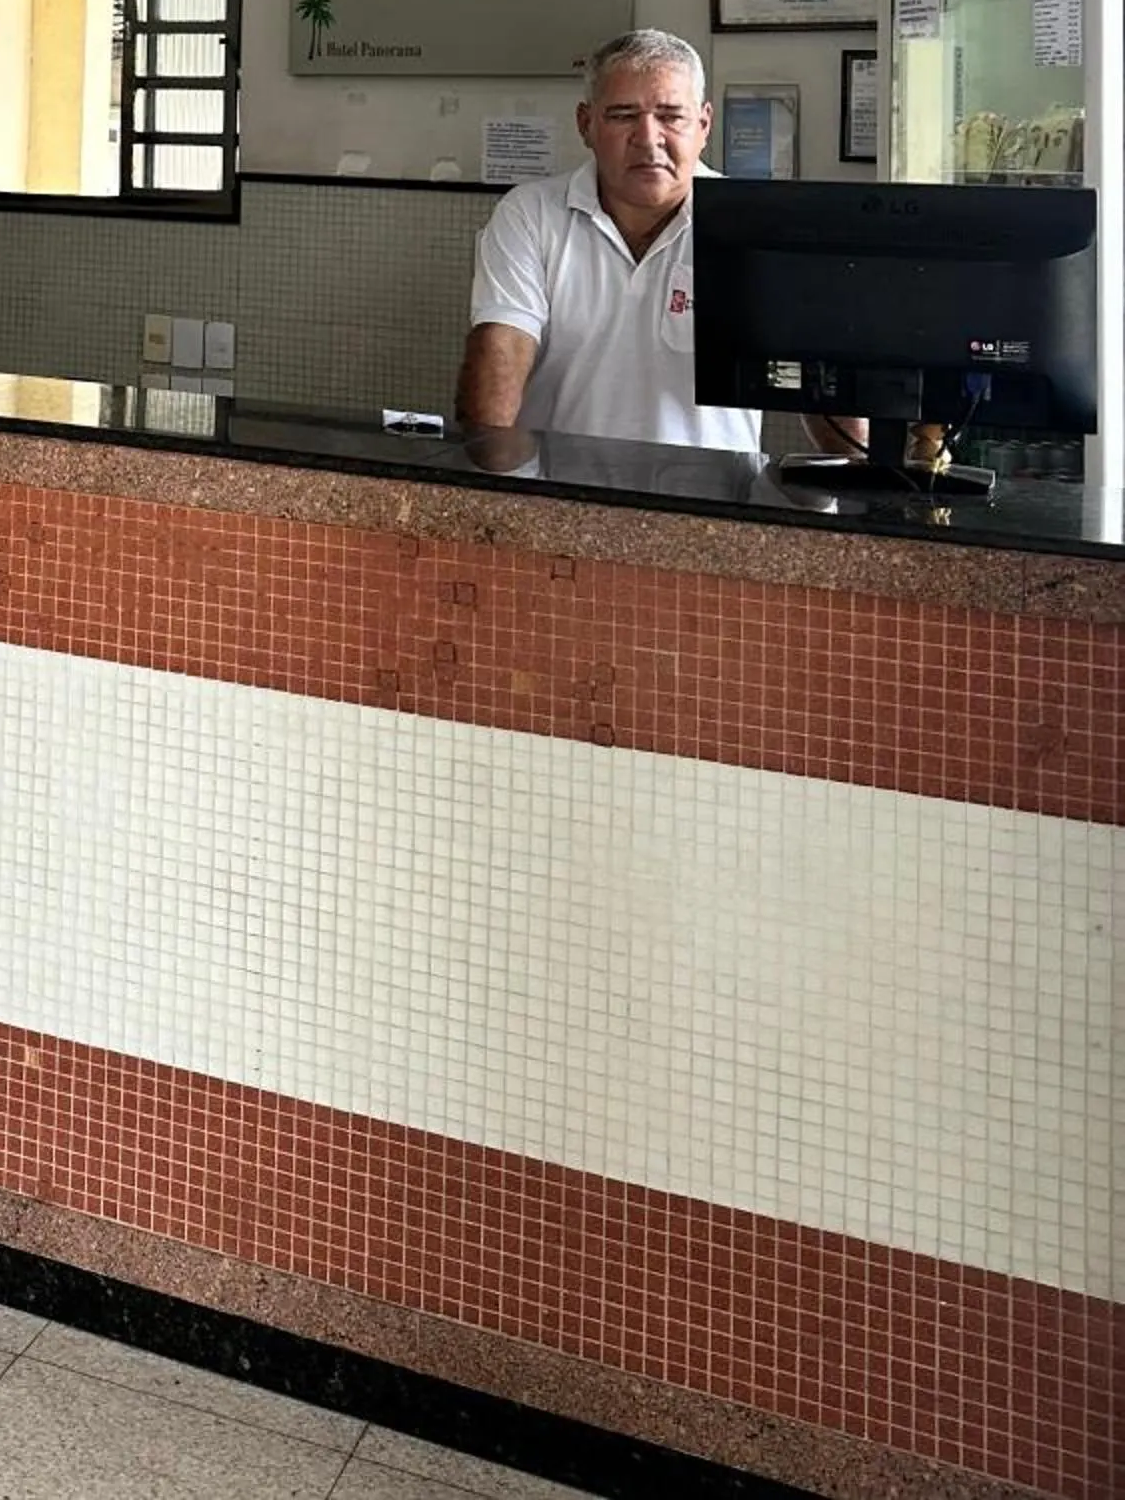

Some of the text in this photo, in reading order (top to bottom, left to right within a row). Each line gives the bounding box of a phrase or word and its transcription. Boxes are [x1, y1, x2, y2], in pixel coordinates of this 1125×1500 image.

[326, 40, 422, 57] Hotel Panorama
[890, 199, 920, 215] LG
